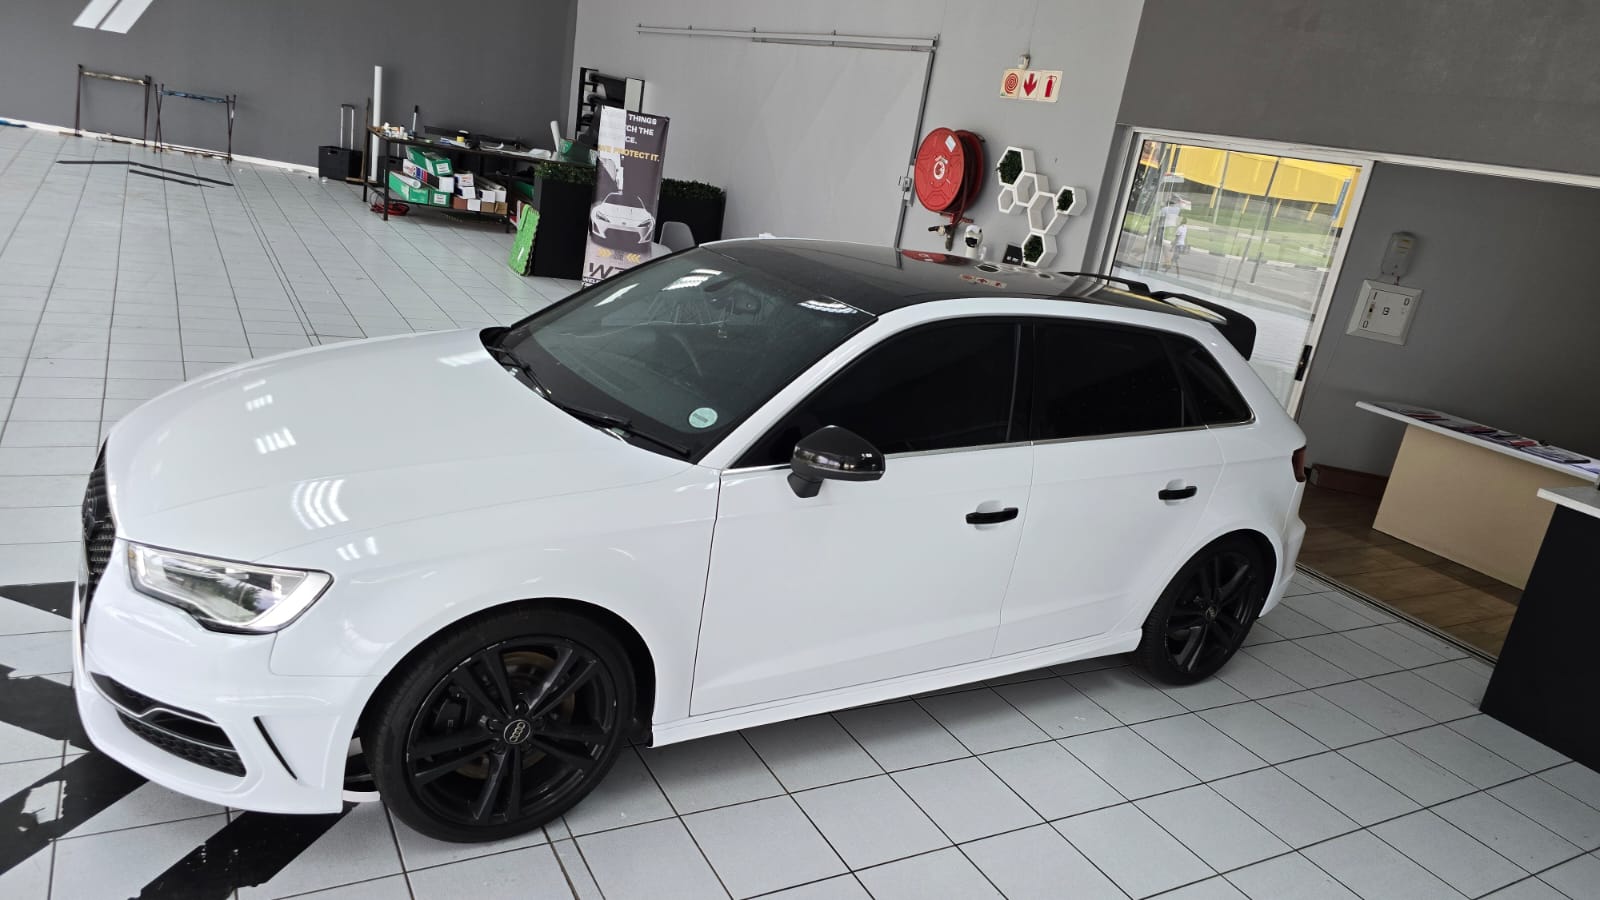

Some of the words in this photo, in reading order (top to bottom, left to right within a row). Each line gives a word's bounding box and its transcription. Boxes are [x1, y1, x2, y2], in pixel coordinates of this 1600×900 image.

[628, 113, 657, 125] THINGS
[638, 127, 655, 136] THE
[613, 146, 649, 159] PROTECT
[649, 153, 660, 162] IT.
